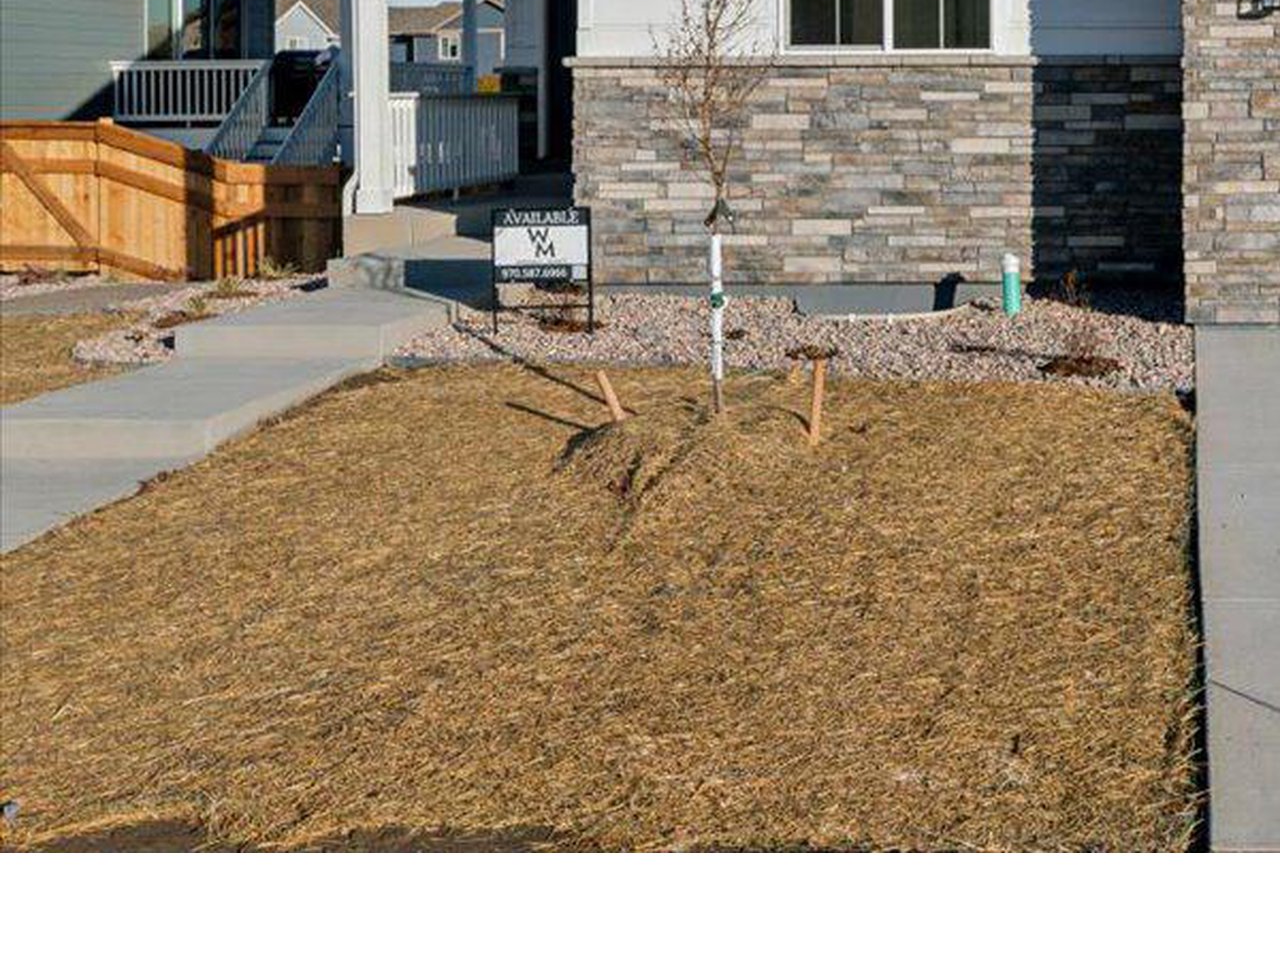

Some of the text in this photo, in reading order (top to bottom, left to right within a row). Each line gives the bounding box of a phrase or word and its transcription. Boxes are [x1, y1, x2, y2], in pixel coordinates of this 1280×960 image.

[504, 209, 579, 224] AVAILABLE
[527, 228, 549, 243] W
[535, 242, 555, 257] M
